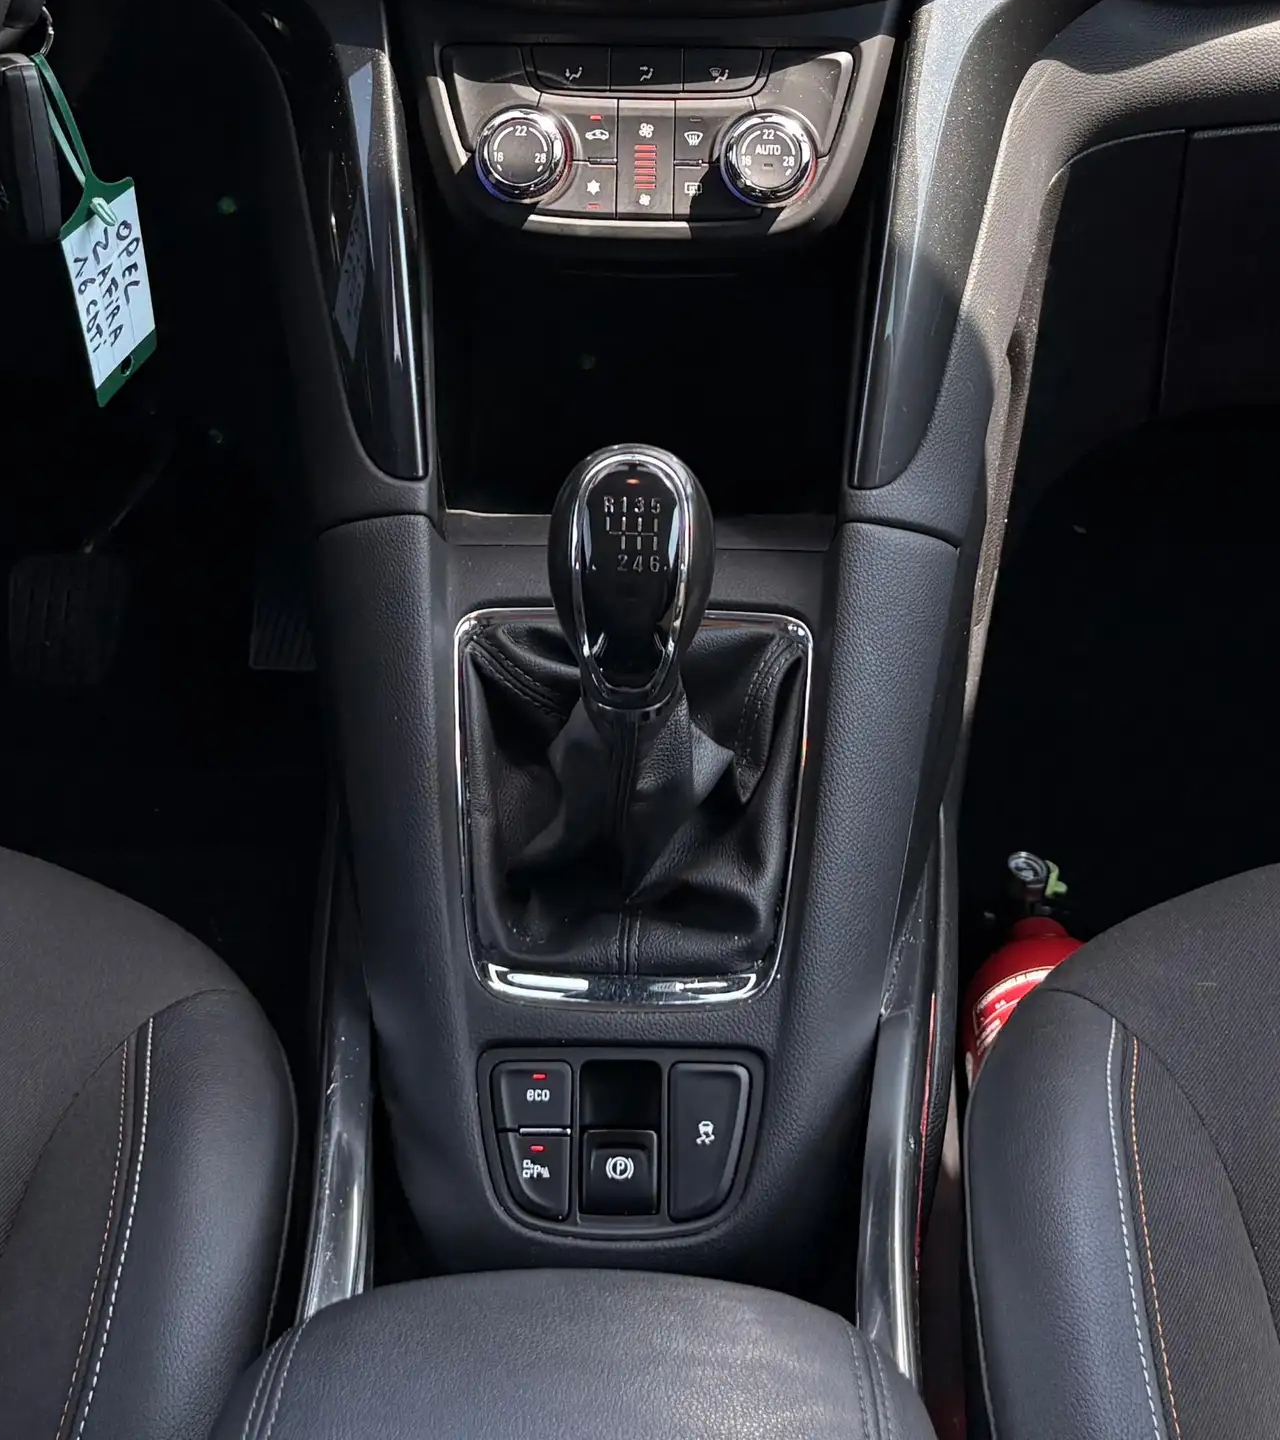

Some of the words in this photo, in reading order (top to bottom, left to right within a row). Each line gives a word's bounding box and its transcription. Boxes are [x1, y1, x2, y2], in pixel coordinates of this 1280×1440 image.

[515, 125, 527, 136] 22
[762, 129, 774, 140] 22
[755, 144, 781, 155] AUTO
[535, 153, 546, 163] 28
[783, 156, 795, 167] 28
[115, 219, 141, 305] OPEL
[603, 496, 614, 513] R
[620, 496, 627, 513] 1
[634, 497, 645, 513] 3
[650, 498, 661, 514] 5
[618, 555, 628, 571] 2
[632, 555, 643, 573] 4
[650, 555, 660, 572] 6
[526, 1088, 550, 1102] eco
